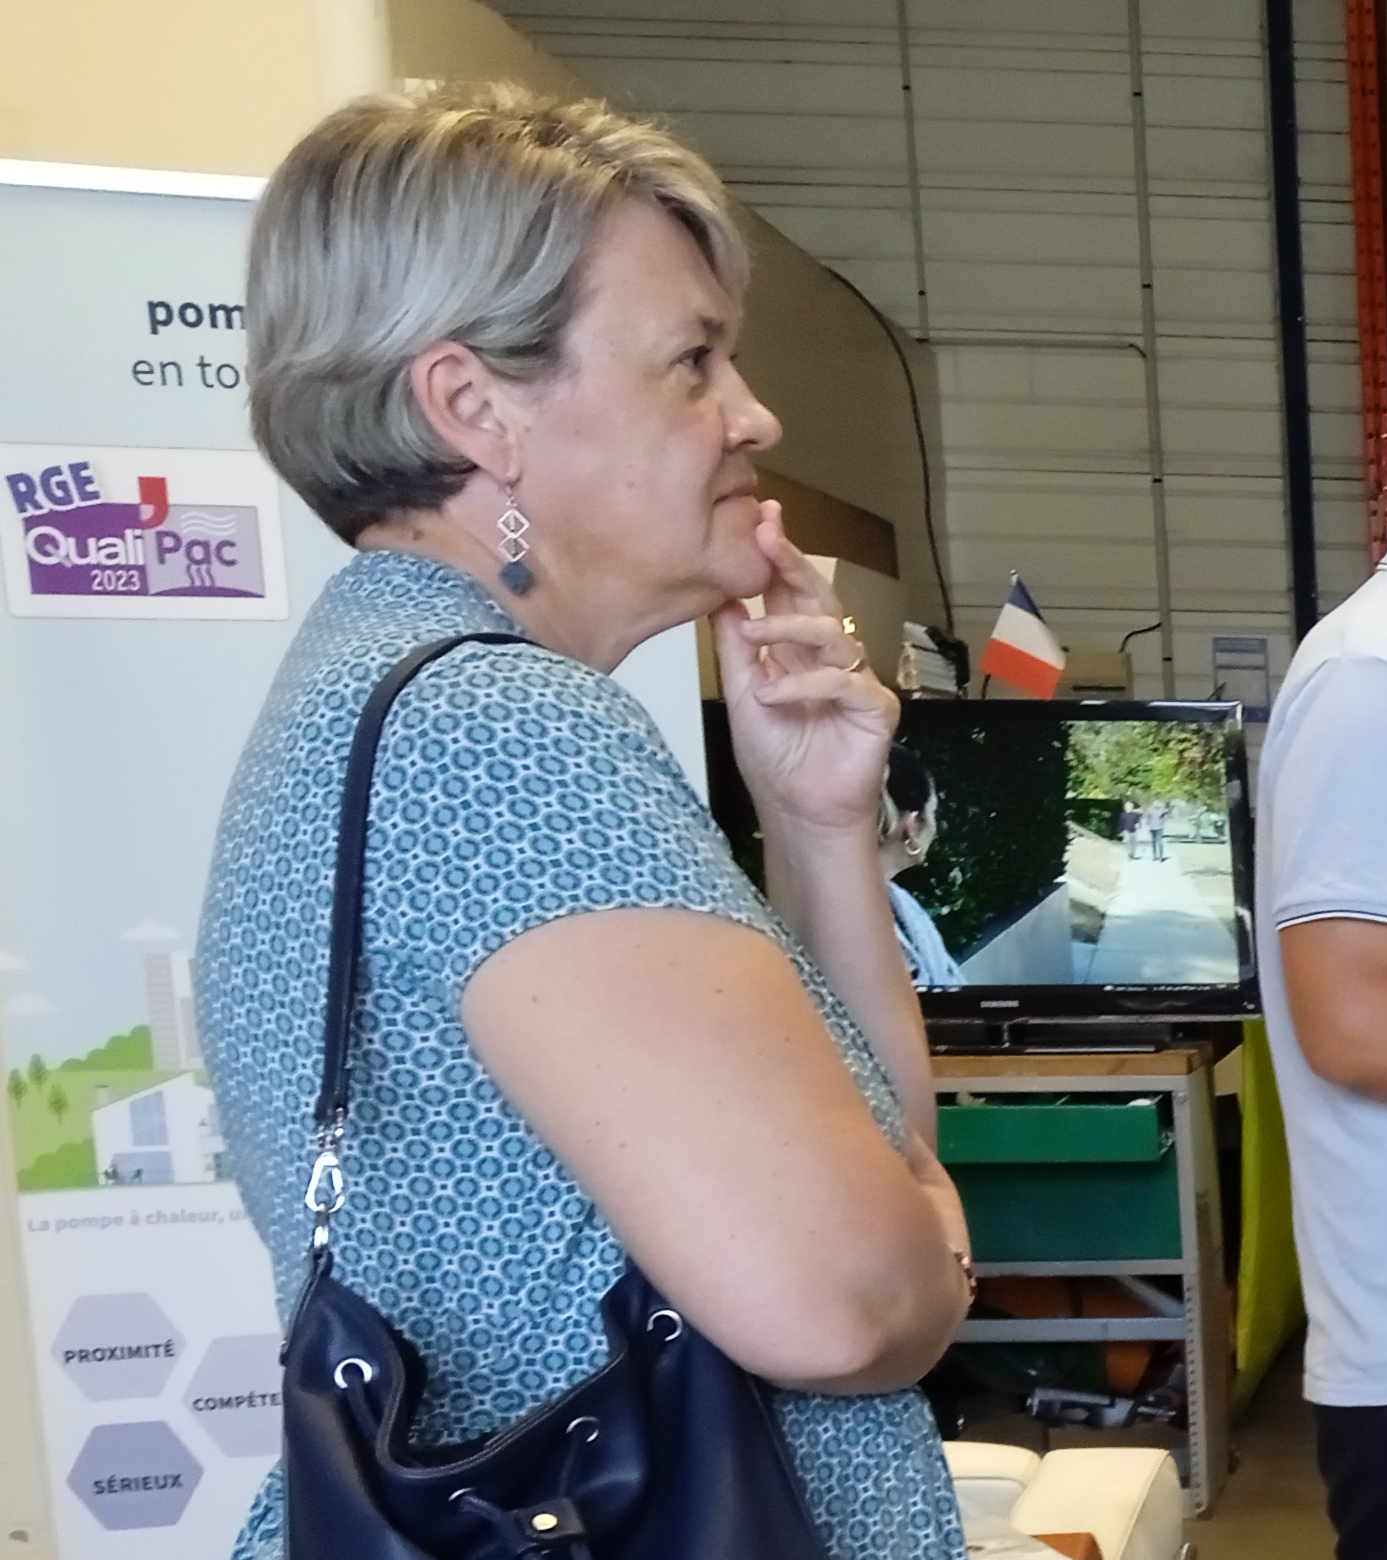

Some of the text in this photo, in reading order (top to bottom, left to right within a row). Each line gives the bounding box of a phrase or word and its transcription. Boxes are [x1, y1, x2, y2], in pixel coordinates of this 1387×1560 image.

[131, 359, 184, 387] en
[5, 461, 101, 514] RGE
[90, 569, 141, 592] 2023
[27, 1218, 50, 1232] La
[55, 1214, 125, 1233] pompe
[129, 1209, 140, 1226] à
[145, 1208, 225, 1224] chaleur,
[63, 1339, 176, 1364] PROXIMITÉ
[192, 1390, 283, 1411] COMPÉTE
[93, 1473, 185, 1495] SÉRIEUX
